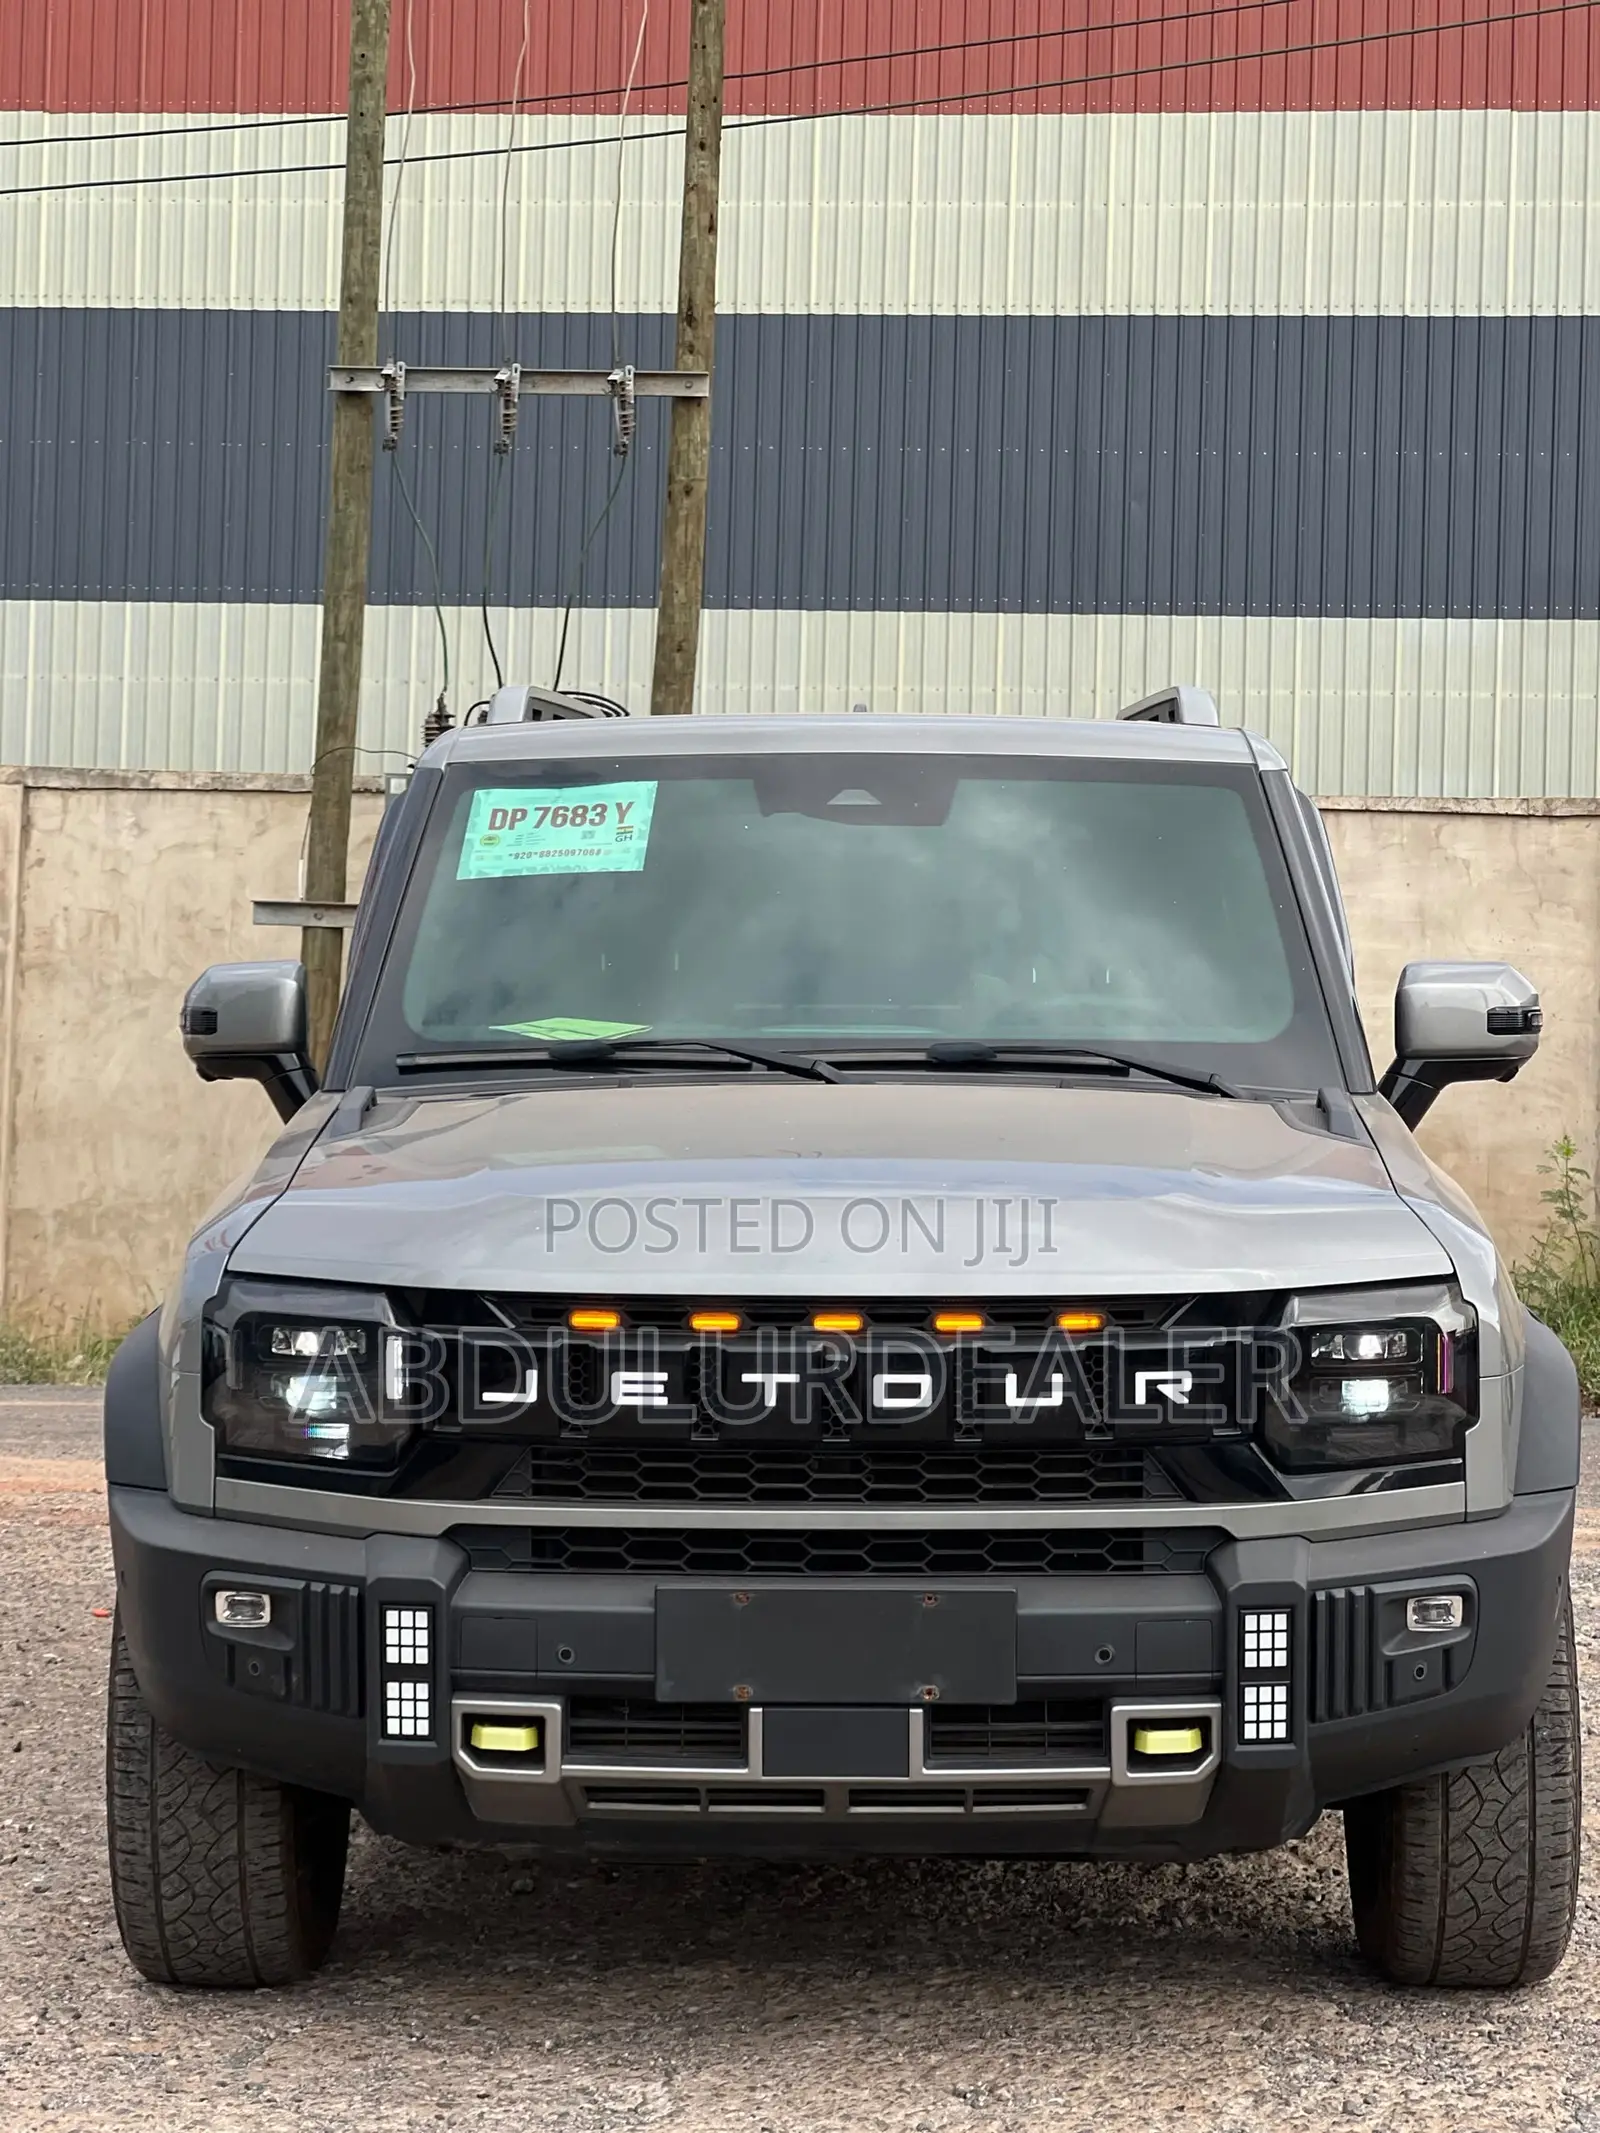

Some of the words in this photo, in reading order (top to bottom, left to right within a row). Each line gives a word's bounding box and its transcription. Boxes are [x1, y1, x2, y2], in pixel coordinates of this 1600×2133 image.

[488, 807, 528, 831] DP
[533, 803, 608, 829] 7683
[615, 801, 635, 825] Y
[615, 833, 633, 843] GH
